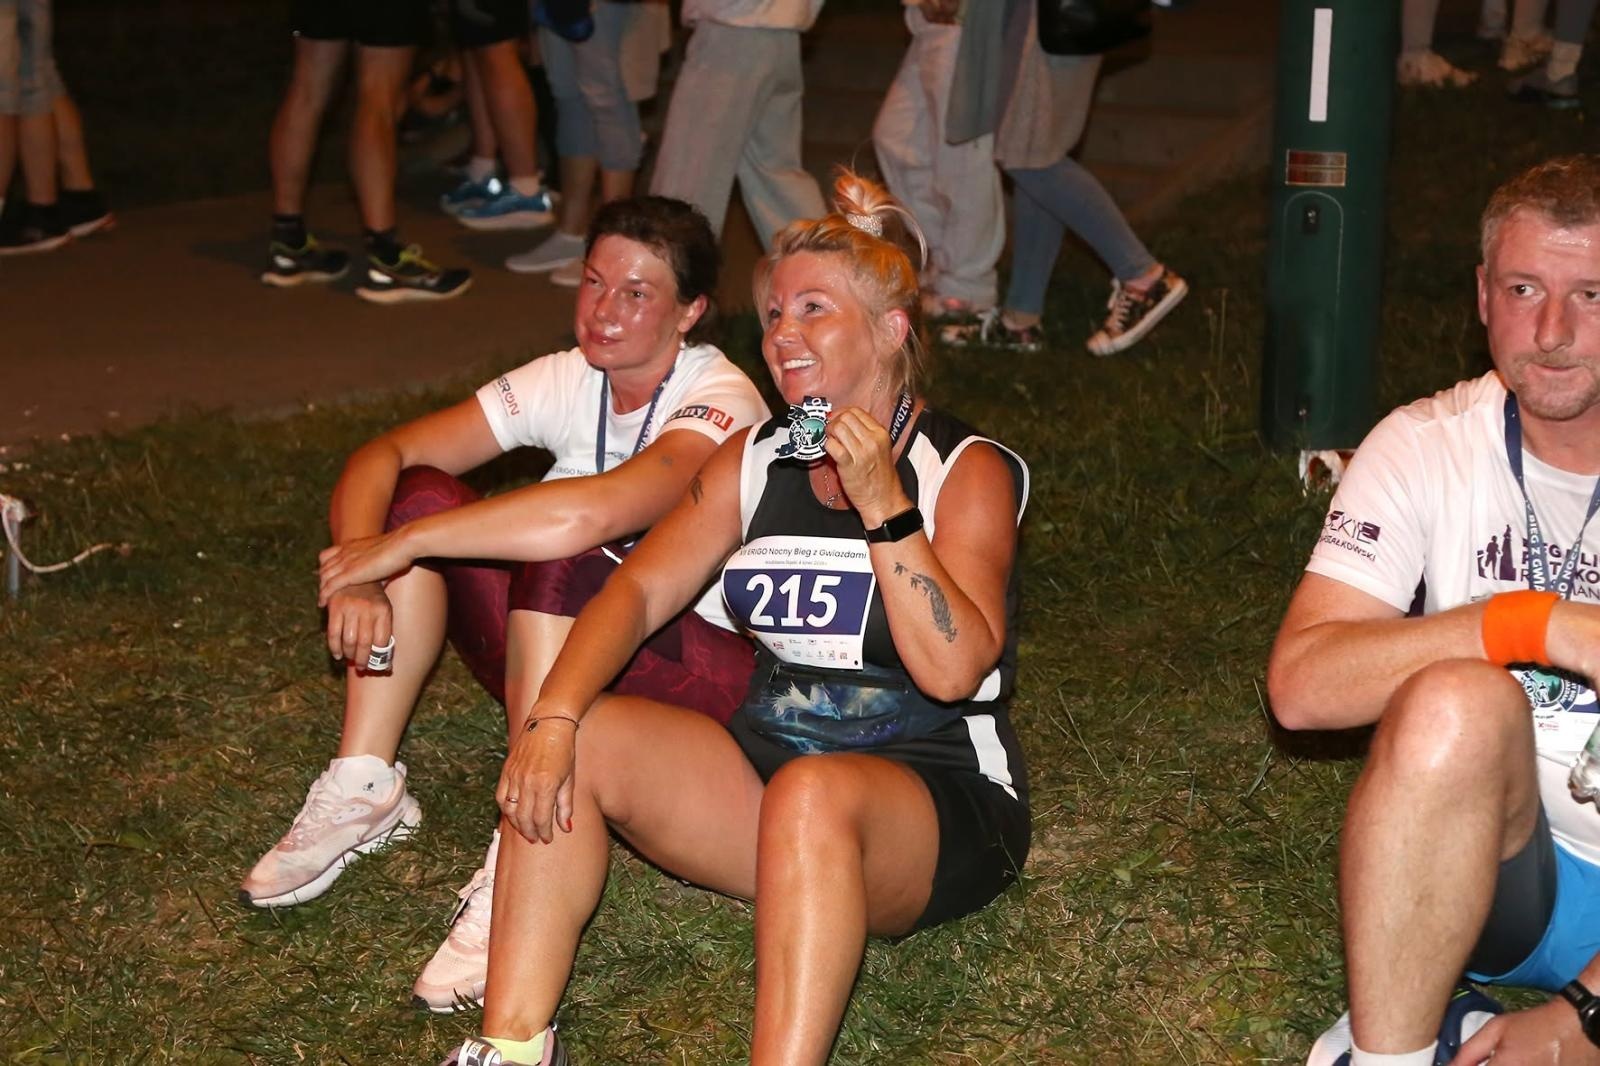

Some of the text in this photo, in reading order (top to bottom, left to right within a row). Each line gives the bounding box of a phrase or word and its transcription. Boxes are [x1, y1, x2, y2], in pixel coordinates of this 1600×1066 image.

[1528, 515, 1540, 544] BIEG
[768, 547, 793, 558] Nocny
[794, 547, 812, 558] Bieg
[819, 549, 867, 560] Gwiazdami
[1531, 547, 1541, 555] Z
[745, 573, 842, 628] 215
